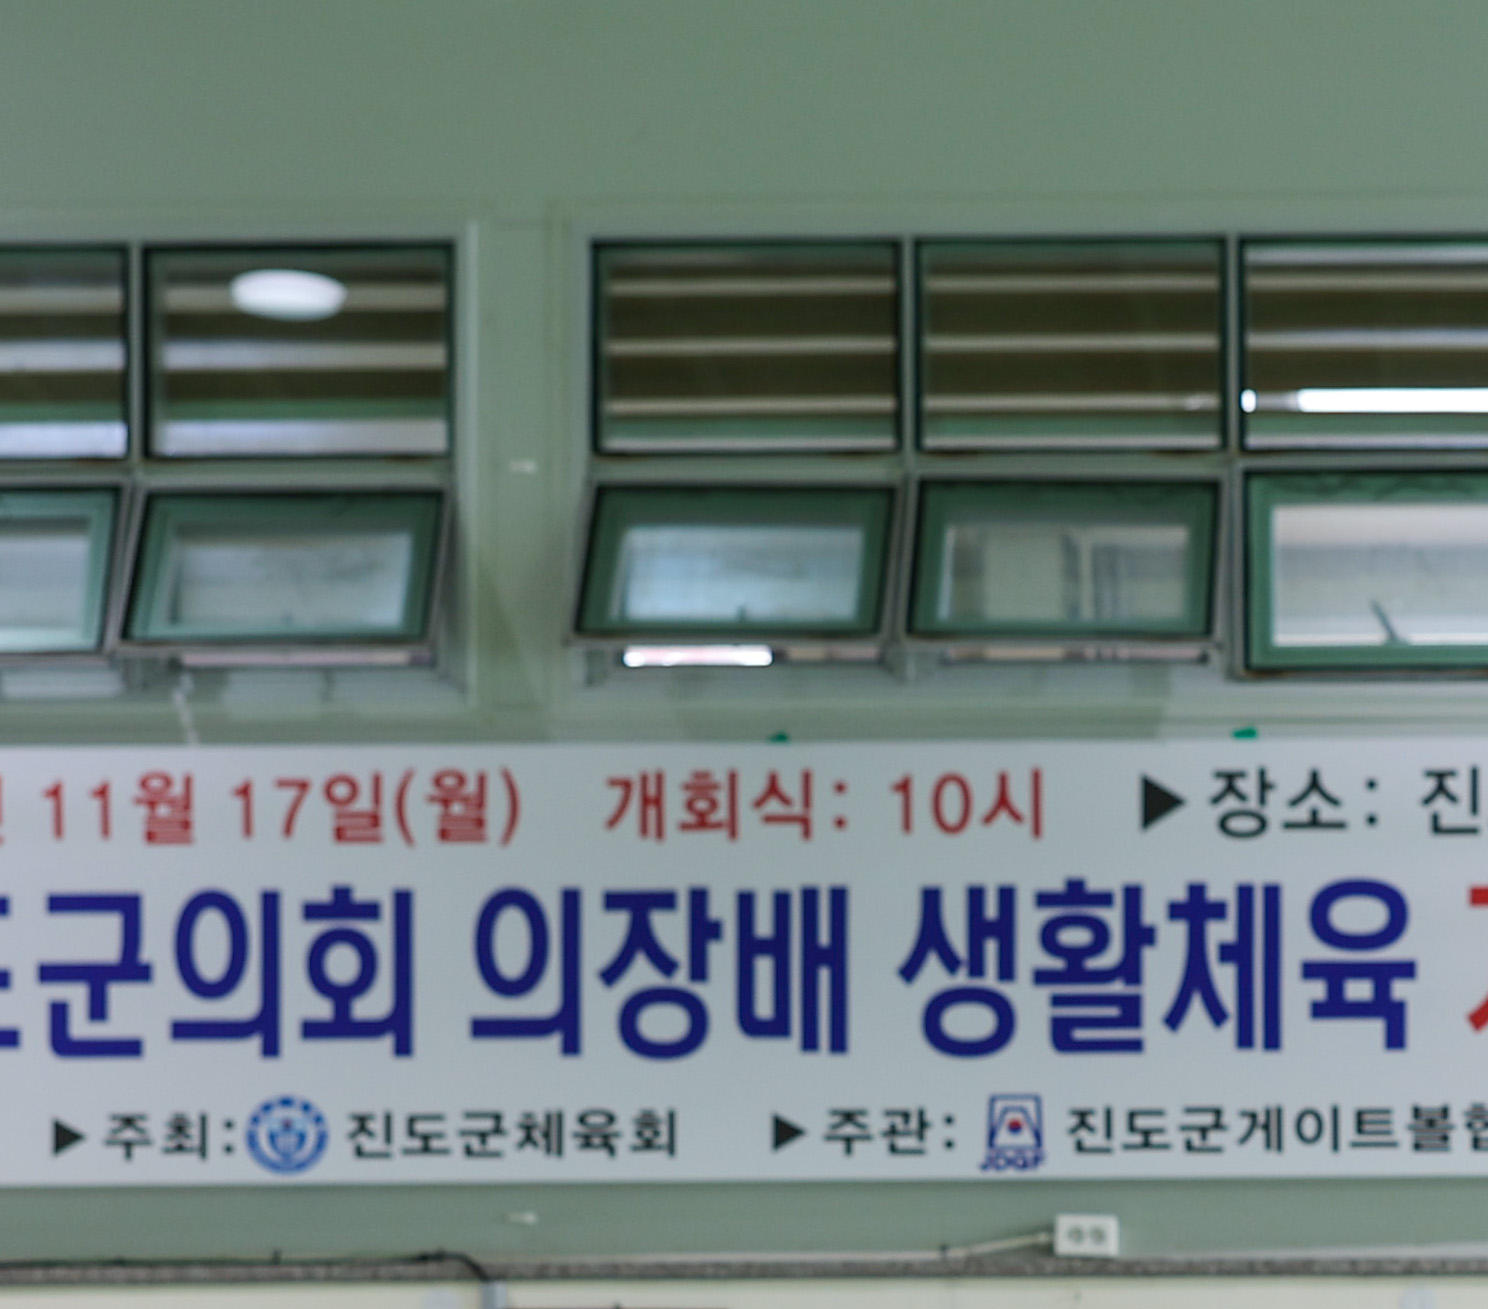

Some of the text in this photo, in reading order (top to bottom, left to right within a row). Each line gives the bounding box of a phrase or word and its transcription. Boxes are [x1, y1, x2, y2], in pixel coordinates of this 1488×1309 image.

[43, 774, 196, 846] 11월
[230, 768, 524, 848] 17일(월)
[604, 768, 848, 844] 개회식:
[890, 768, 1044, 838] 10시
[1208, 764, 1380, 842] 장소:
[468, 883, 851, 1063] 의장배
[895, 875, 1419, 1061] 생활체육
[104, 1107, 678, 1161] 주최: 진도군체육회
[822, 1106, 956, 1158] 주관:
